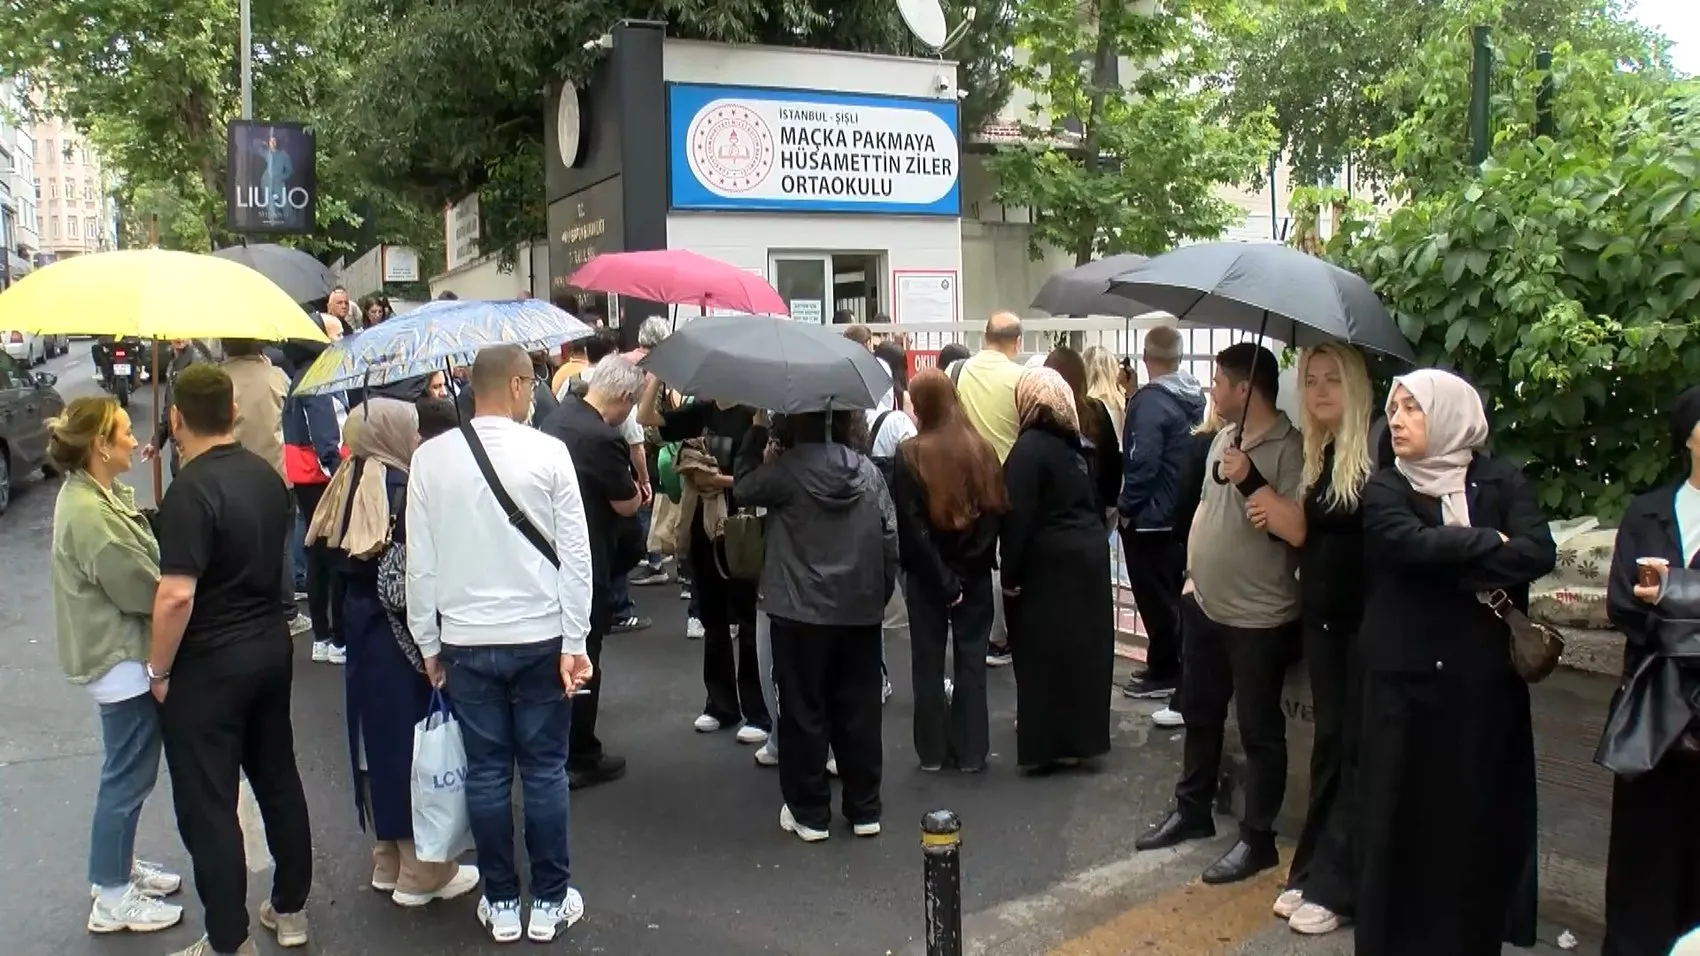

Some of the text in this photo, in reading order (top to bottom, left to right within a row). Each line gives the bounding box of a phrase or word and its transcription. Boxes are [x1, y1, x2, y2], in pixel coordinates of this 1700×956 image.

[779, 108, 827, 122] İSTANBUL
[835, 110, 859, 126] ŞİŞLİ
[780, 127, 936, 153] MAÇKA PAKMAYA
[781, 147, 901, 174] HÜSAMETTİN
[905, 153, 952, 176] ZİLER
[781, 175, 893, 197] ORTAOKULU
